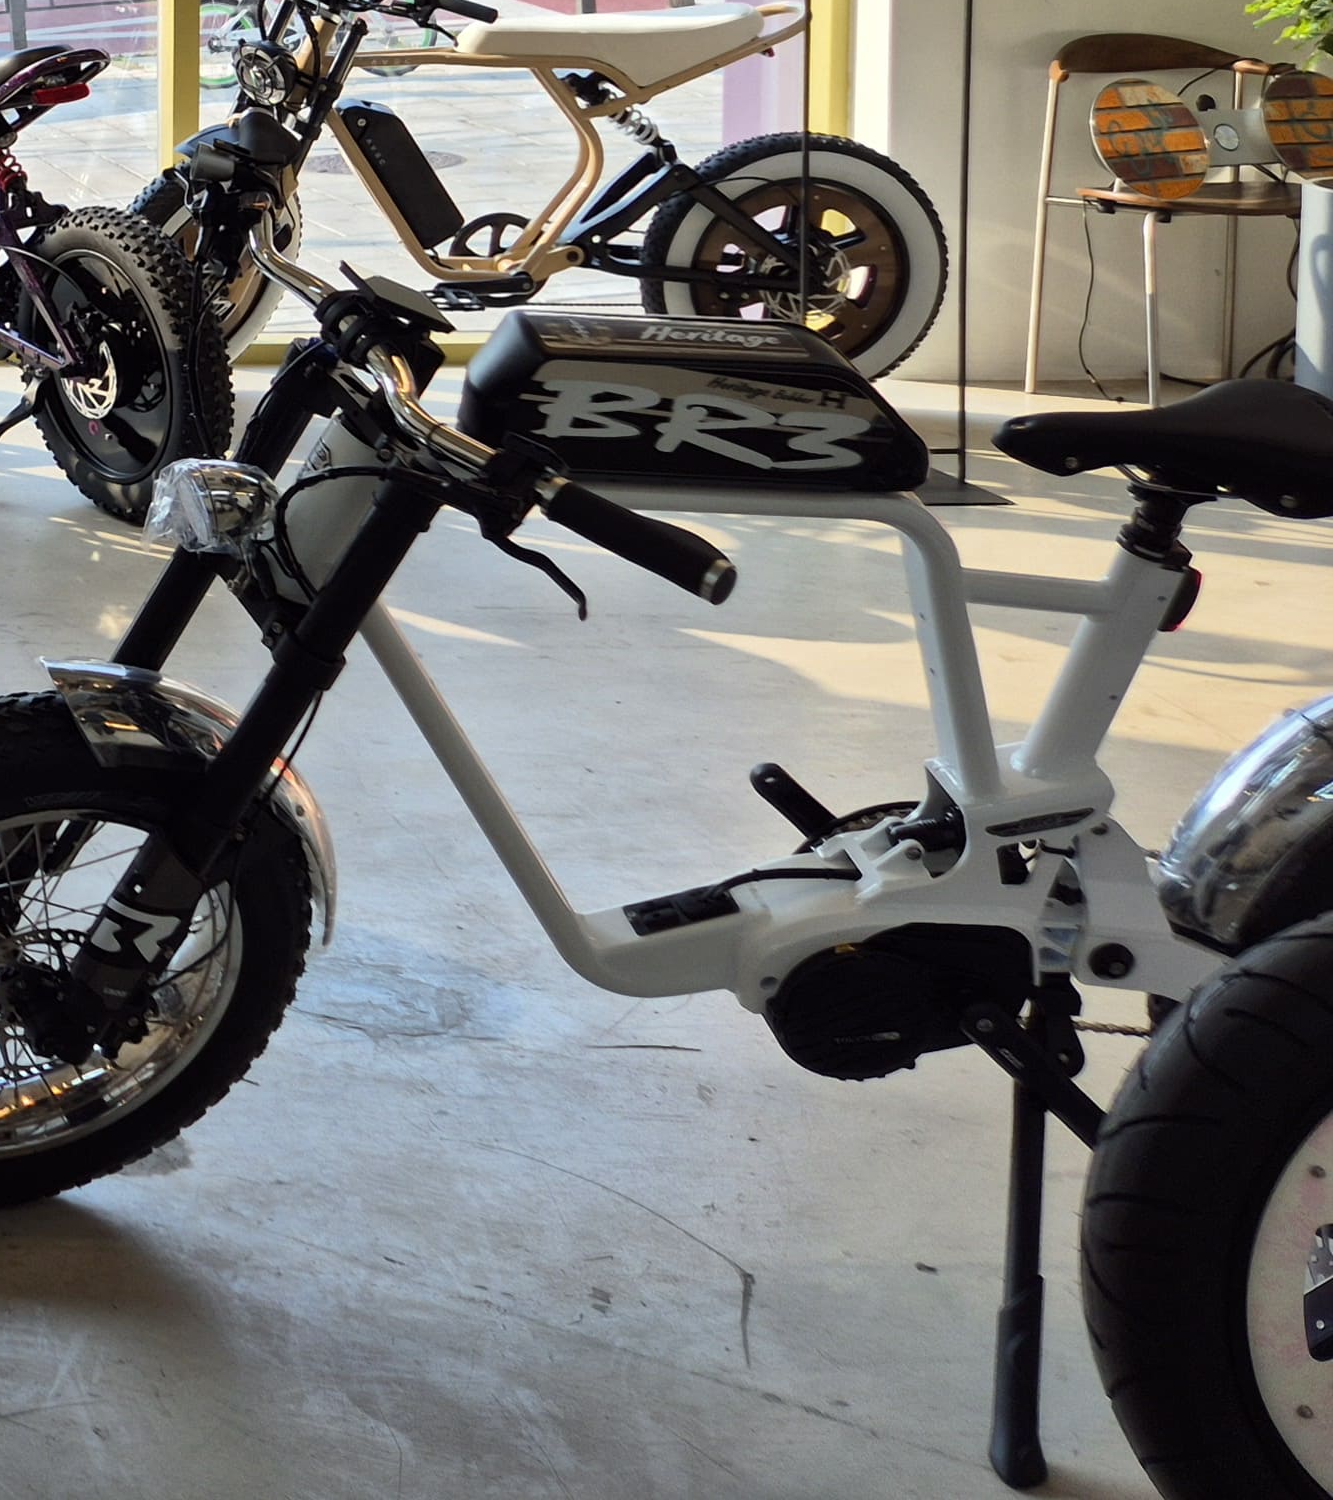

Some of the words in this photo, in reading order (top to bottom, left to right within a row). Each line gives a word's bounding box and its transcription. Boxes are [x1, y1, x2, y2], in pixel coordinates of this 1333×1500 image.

[639, 325, 782, 348] Heritage
[706, 376, 771, 399] Heritage
[531, 378, 873, 471] BR3
